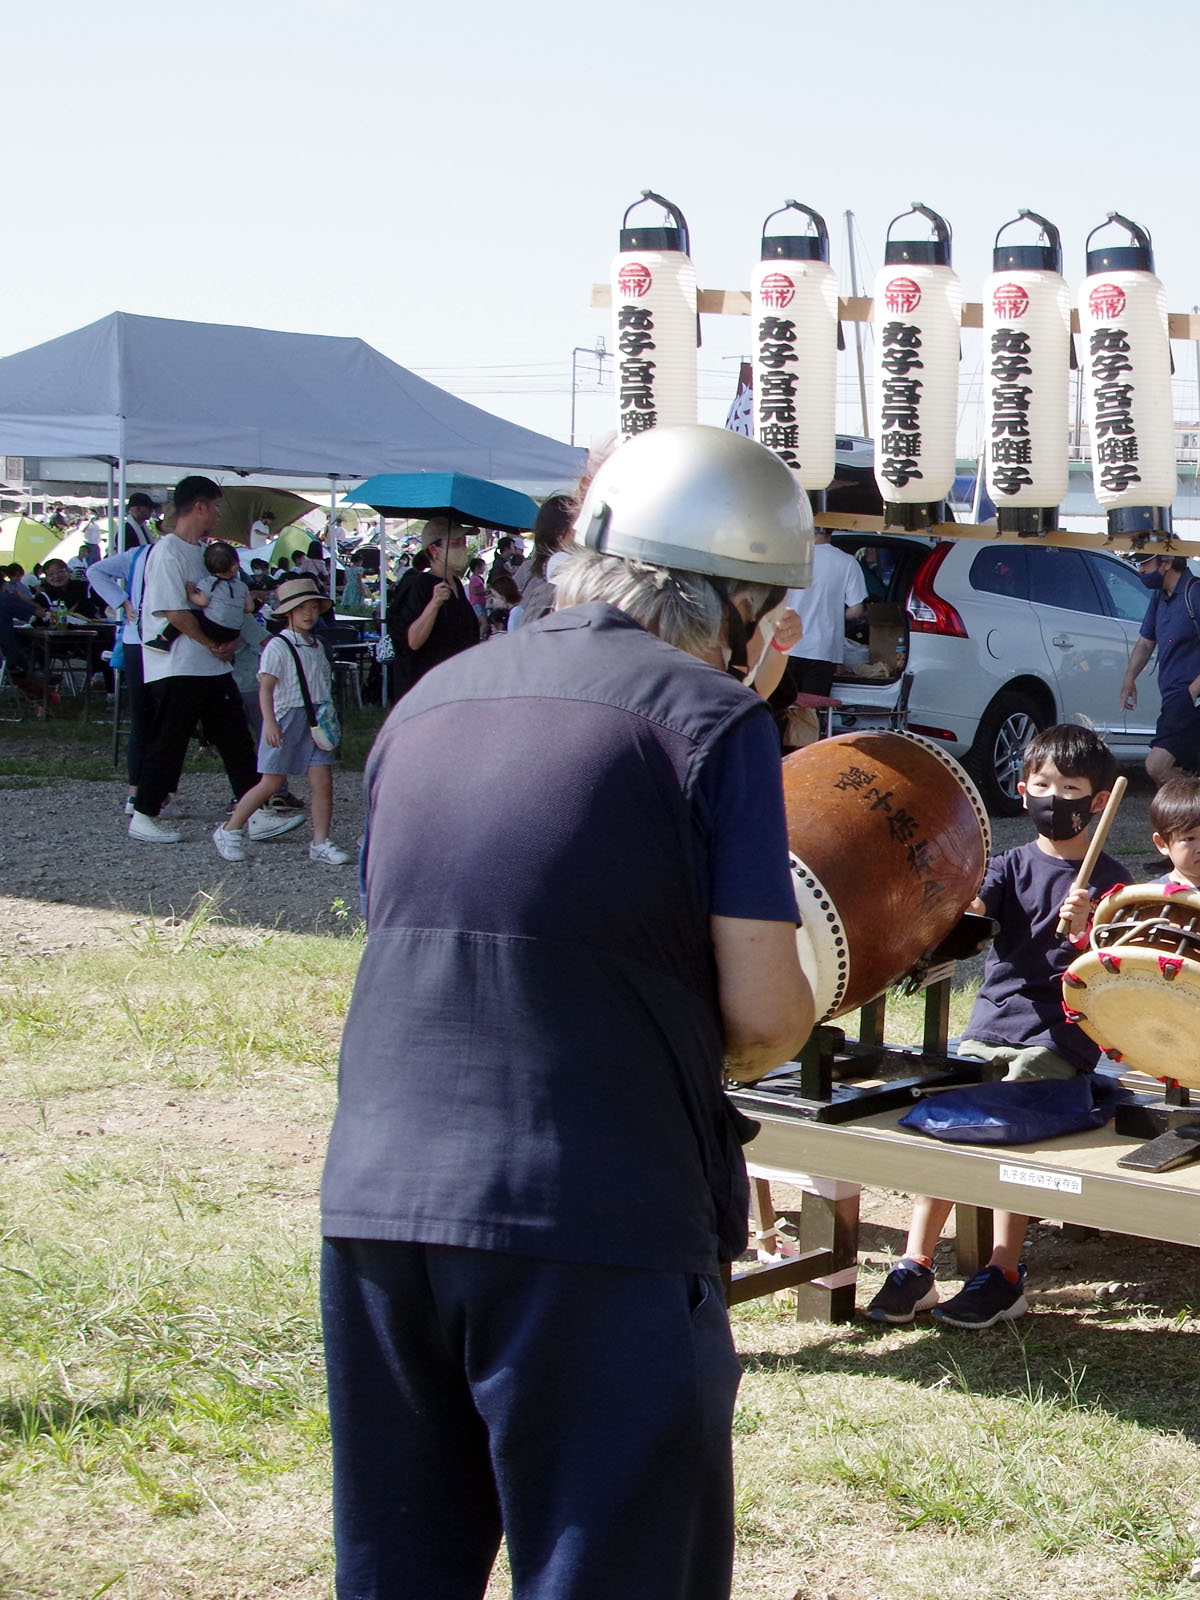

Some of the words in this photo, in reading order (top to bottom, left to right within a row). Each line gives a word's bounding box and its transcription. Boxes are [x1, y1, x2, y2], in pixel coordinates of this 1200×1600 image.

[617, 305, 659, 443] 丸子宮元囃
